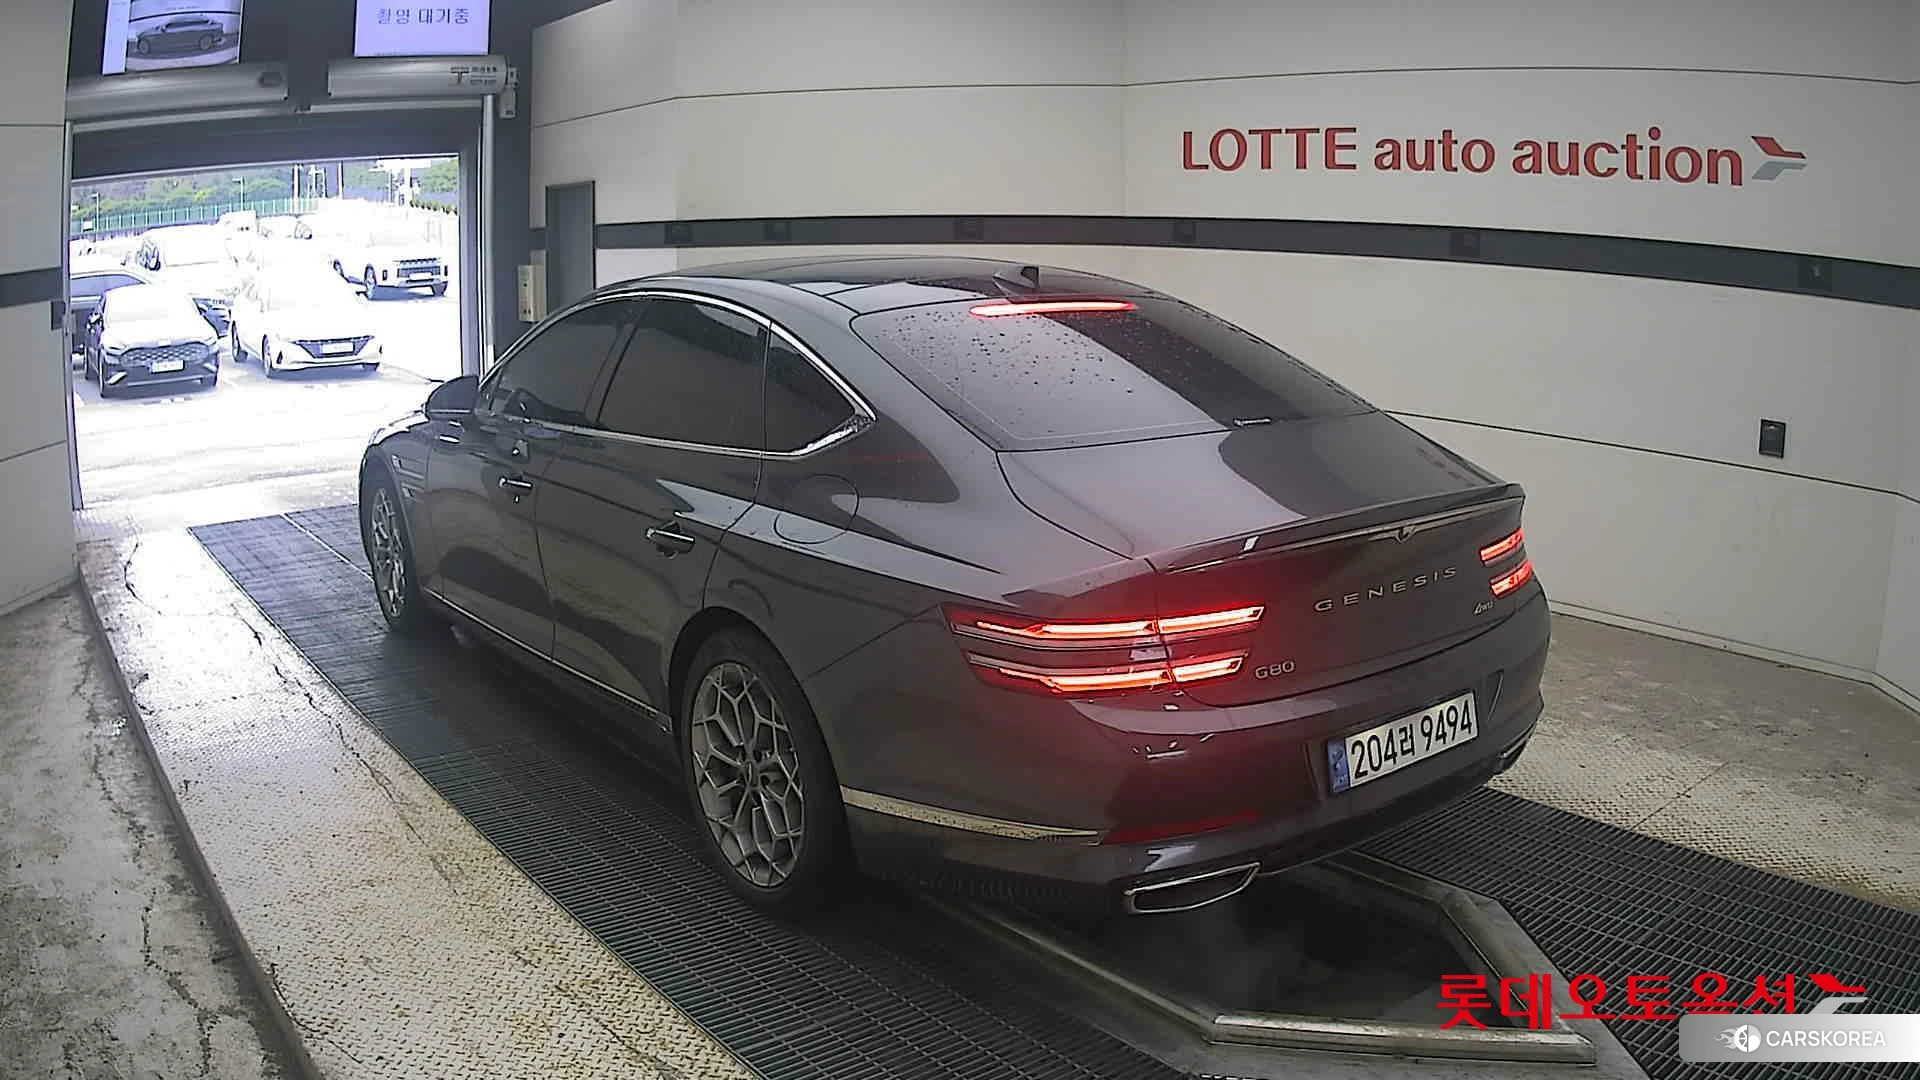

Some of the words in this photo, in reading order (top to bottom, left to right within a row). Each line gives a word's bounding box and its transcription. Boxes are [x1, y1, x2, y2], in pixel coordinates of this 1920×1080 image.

[418, 8, 469, 25] 대기중
[1182, 127, 1358, 171] LOTTE
[1373, 129, 1496, 173] auto
[1512, 126, 1743, 187] auction
[1314, 567, 1457, 611] GENESIS
[1255, 660, 1296, 680] G80
[1351, 723, 1416, 780] 204러
[1420, 699, 1473, 752] 9494
